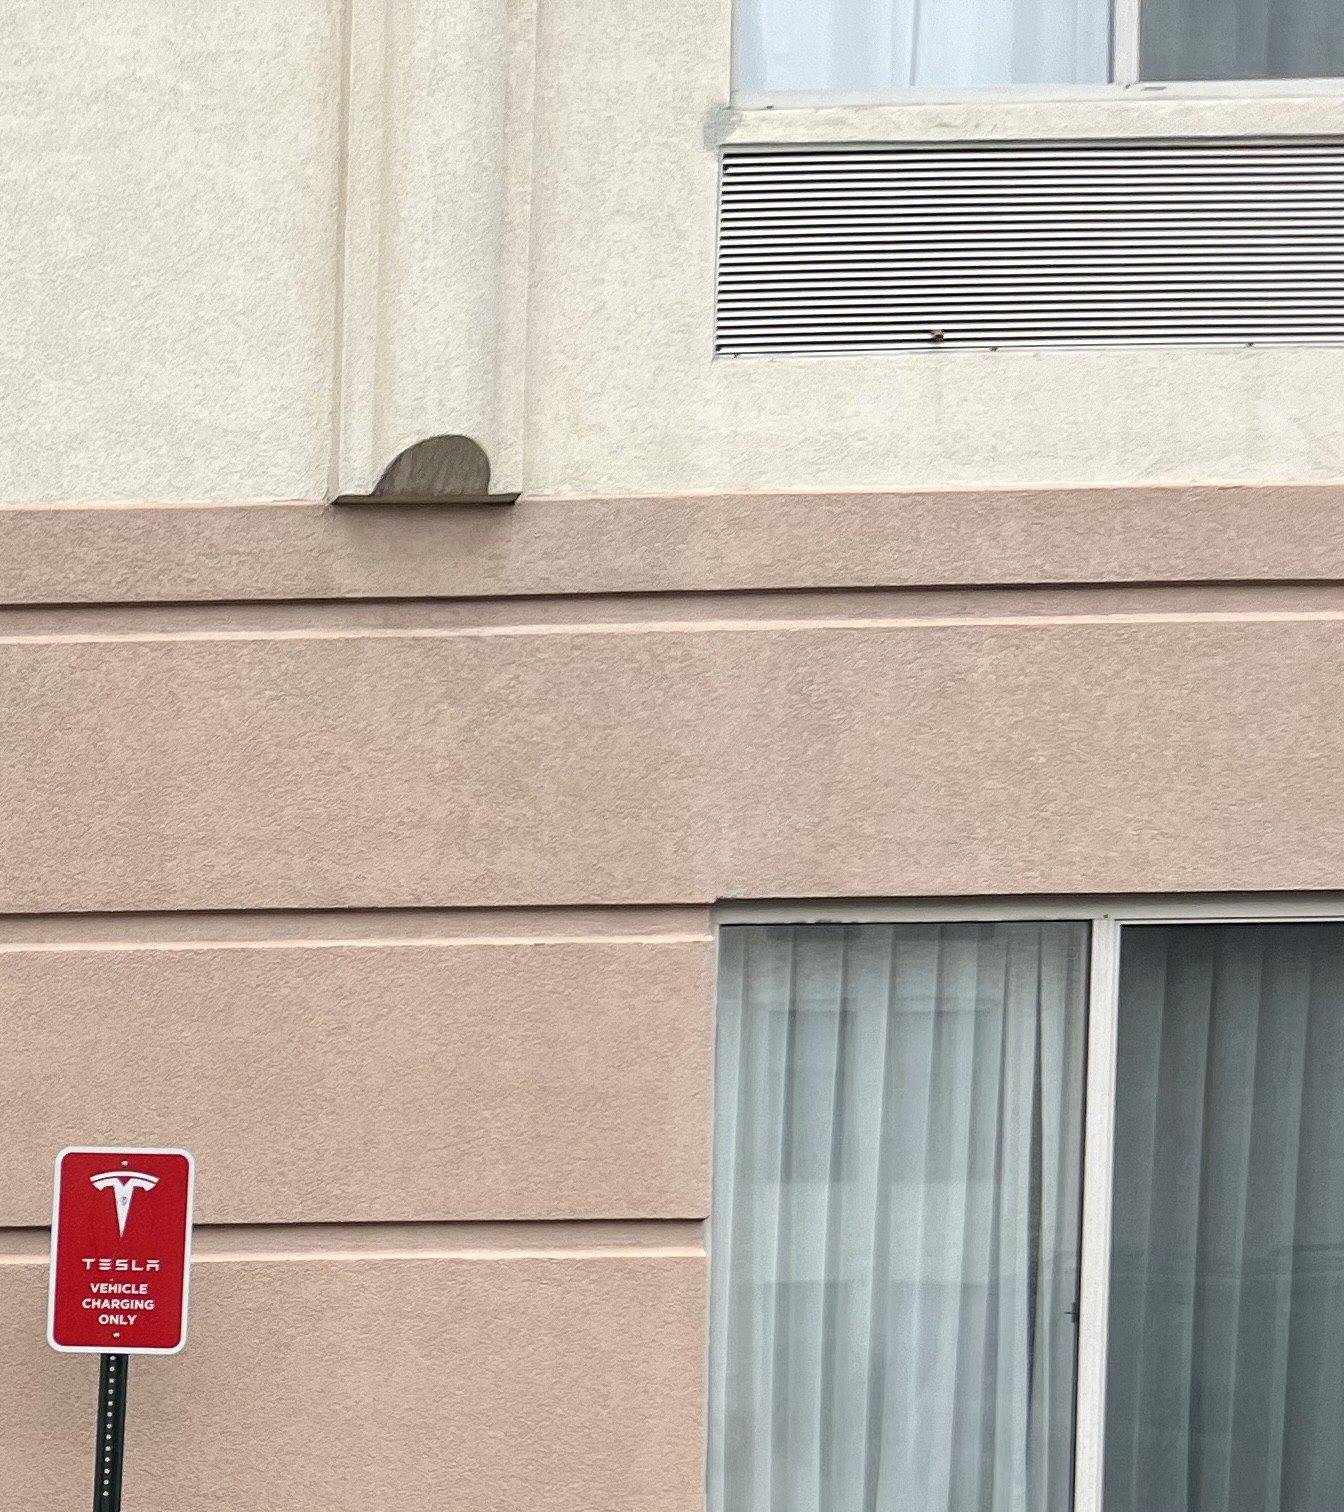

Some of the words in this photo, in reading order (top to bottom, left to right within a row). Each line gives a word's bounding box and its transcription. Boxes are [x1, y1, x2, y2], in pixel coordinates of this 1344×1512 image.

[81, 1258, 160, 1272] TESLA
[90, 1282, 148, 1295] VEHICLE
[81, 1297, 155, 1310] CHARGING
[98, 1314, 137, 1325] ONLY
